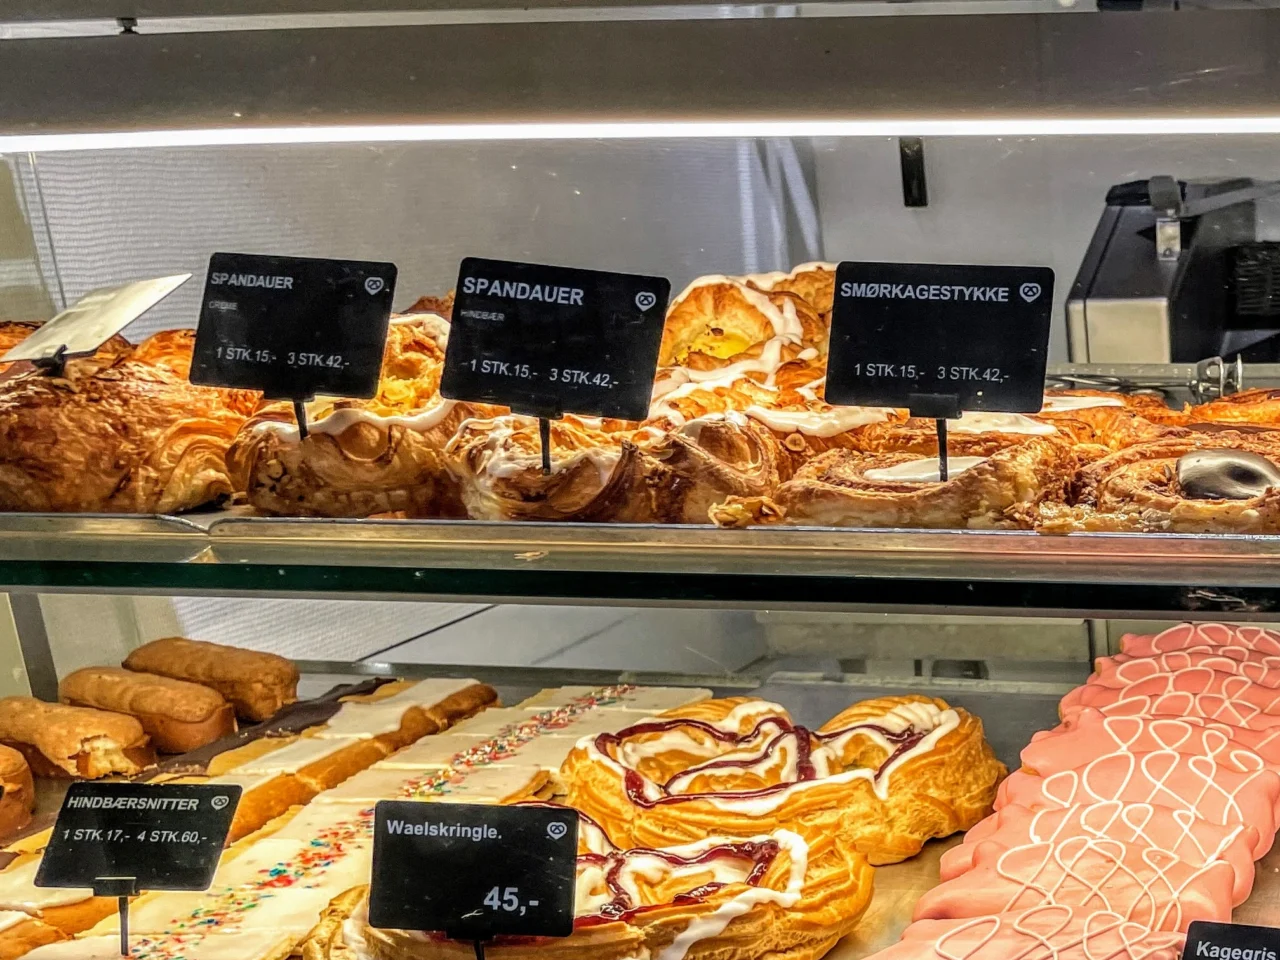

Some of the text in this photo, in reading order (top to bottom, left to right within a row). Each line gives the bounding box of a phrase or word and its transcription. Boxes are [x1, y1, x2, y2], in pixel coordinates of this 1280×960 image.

[211, 272, 294, 289] SPANDAUER
[463, 277, 584, 306] SPANDAUER
[840, 282, 1009, 302] SMØRKAGESTYKKE
[216, 348, 222, 359] 1
[287, 352, 295, 364] 3
[470, 359, 619, 389] 1 STK.15,- 3 STK.42,-
[854, 363, 1009, 383] 1 STK.15,- 3 STK.42,-
[67, 796, 200, 811] HINDBÆRSNITTER
[63, 829, 207, 845] 1 STK.17,- 4 STK.60,-
[387, 819, 502, 842] Waelskringle.
[483, 886, 539, 916] 45,-
